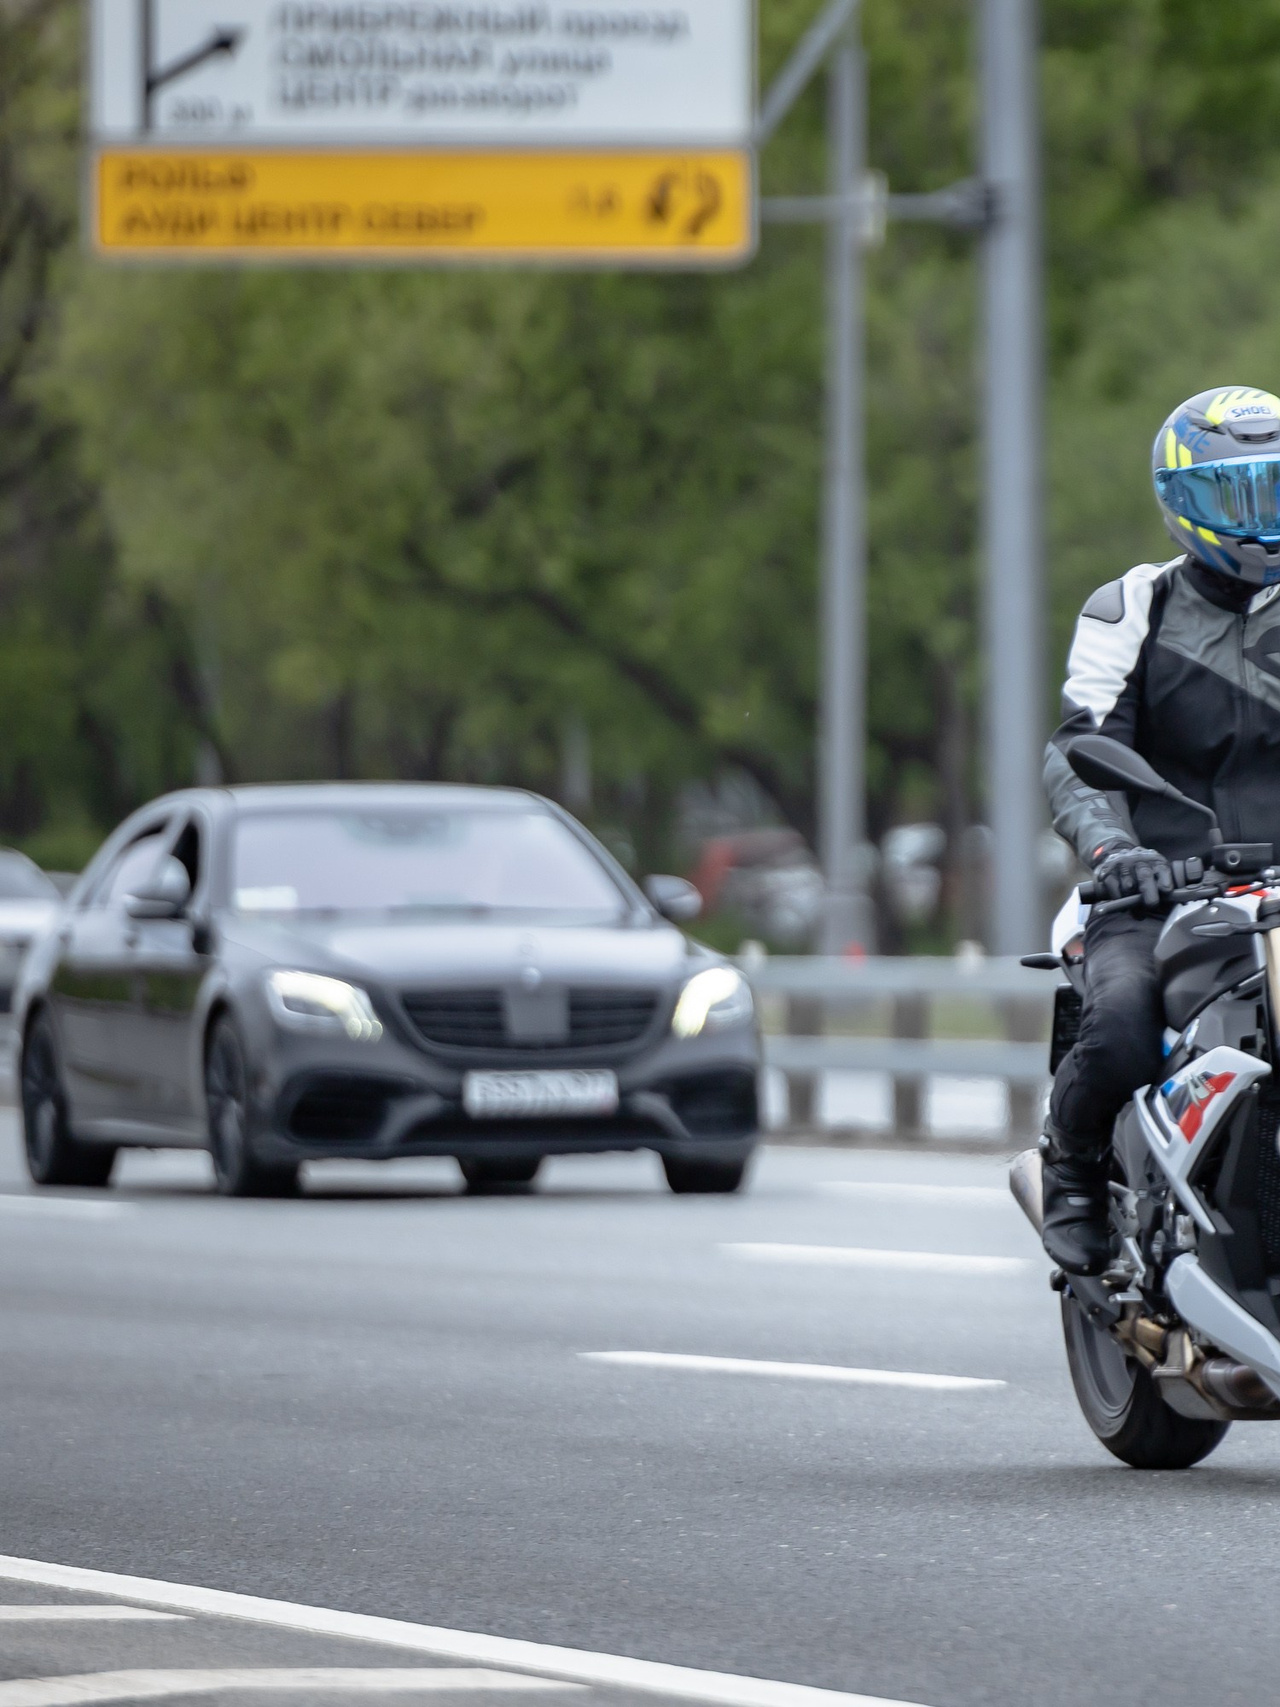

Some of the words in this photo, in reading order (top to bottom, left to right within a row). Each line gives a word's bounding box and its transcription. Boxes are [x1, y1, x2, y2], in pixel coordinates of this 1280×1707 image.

[276, 38, 493, 70] СМОЛЬНАЯ
[276, 76, 398, 110] ЦЕНТР
[119, 161, 253, 194] РОЛЬФ
[119, 203, 215, 238] АУДИ
[230, 203, 345, 237] ЦЕНТР
[359, 204, 485, 235] СЕВЕР
[1231, 406, 1271, 418] SHOEI
